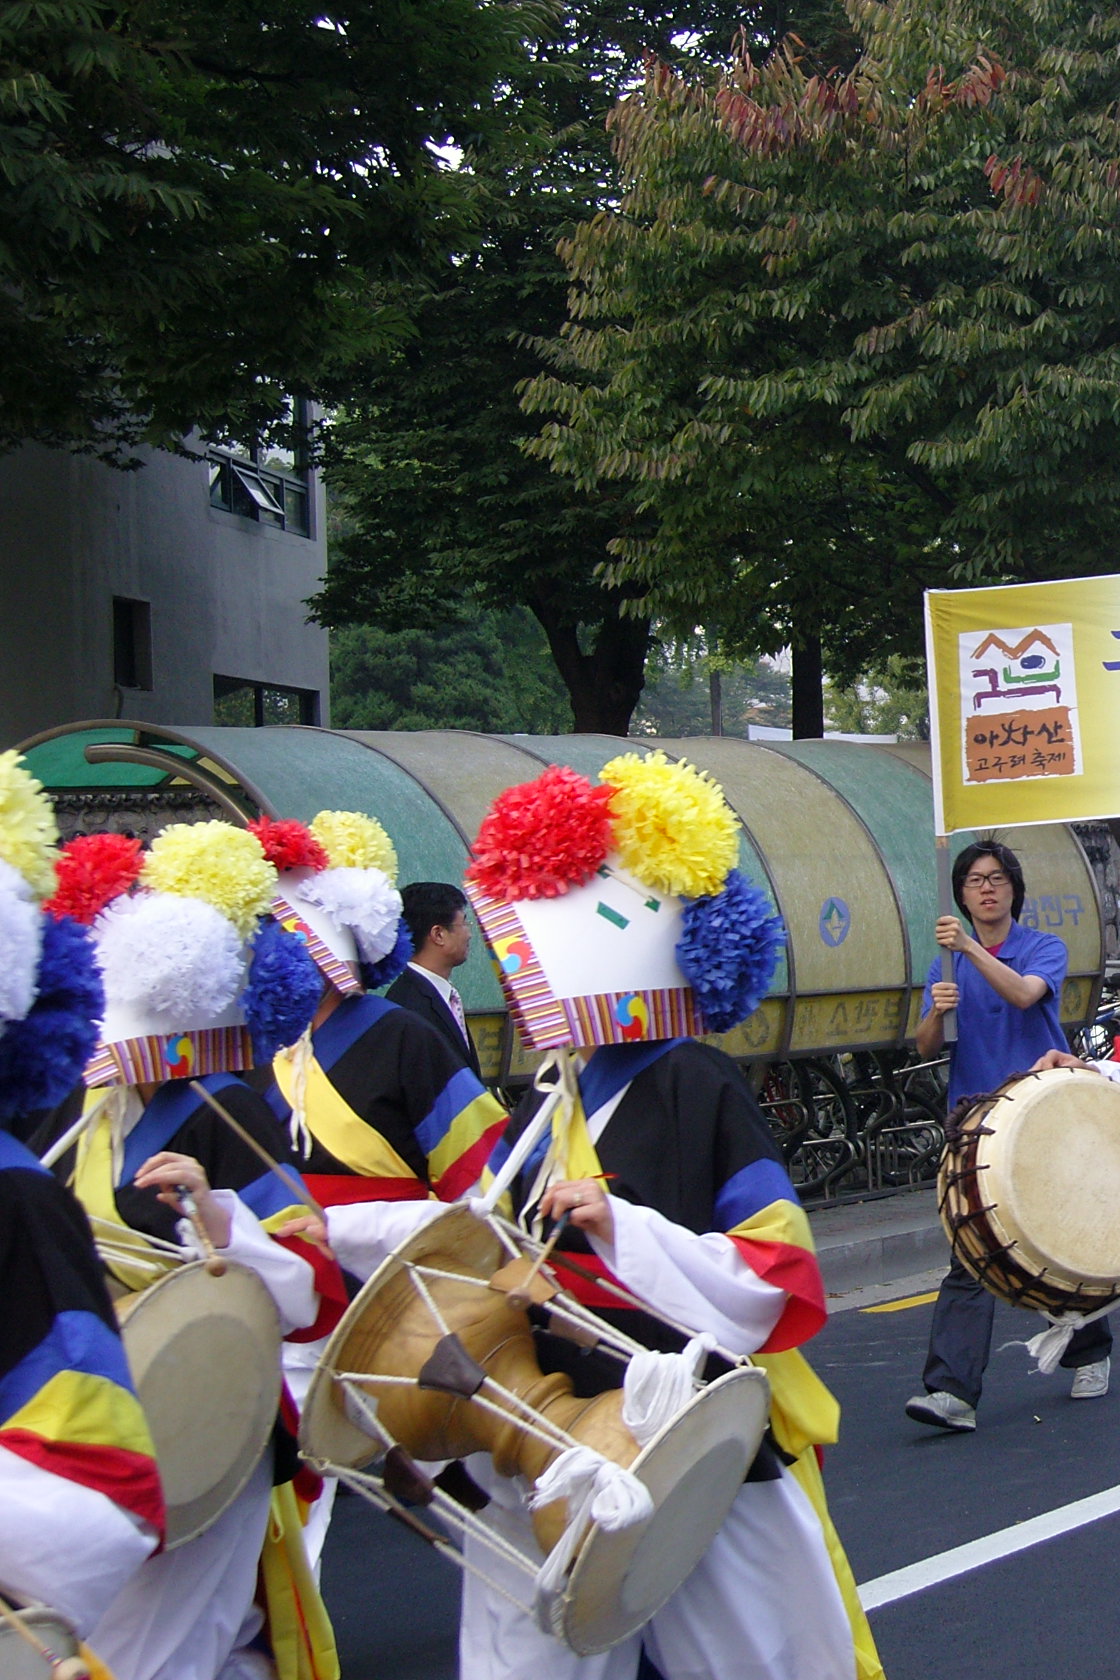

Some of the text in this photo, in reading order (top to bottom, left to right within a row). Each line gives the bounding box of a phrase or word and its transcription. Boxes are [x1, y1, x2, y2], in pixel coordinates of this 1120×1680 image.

[973, 719, 1066, 748] 아차산
[975, 748, 1066, 773] 고구려 축제
